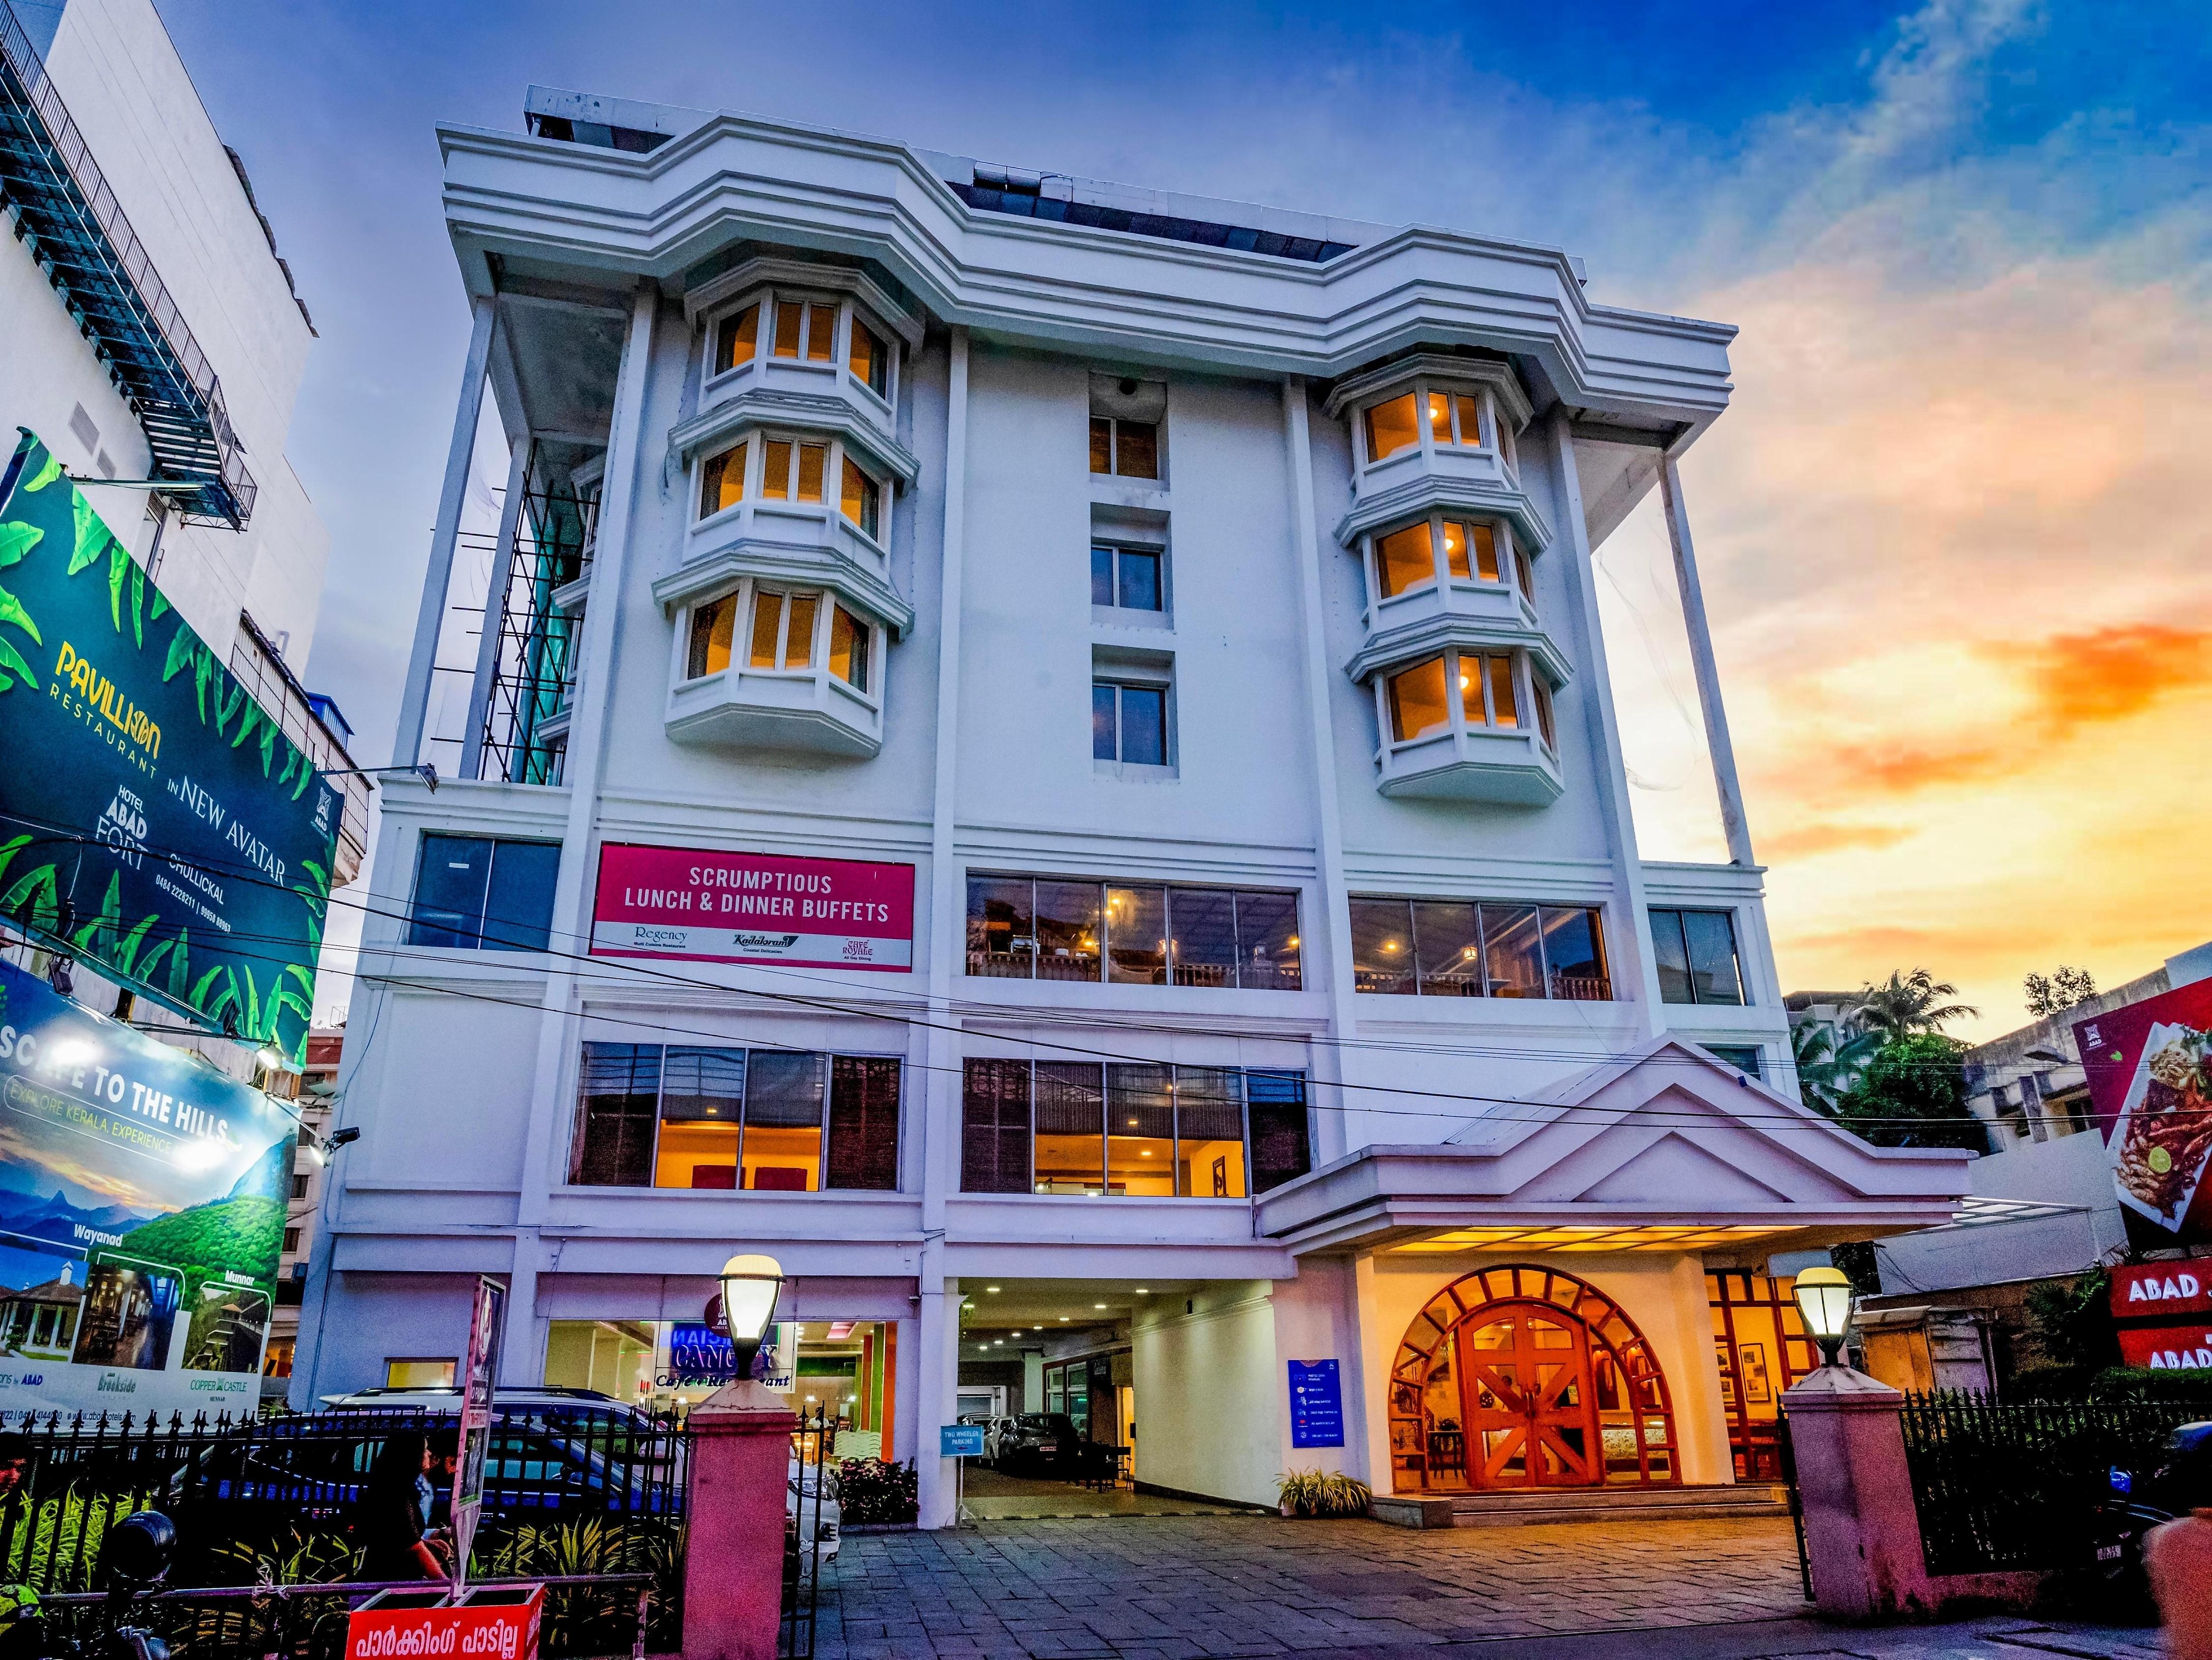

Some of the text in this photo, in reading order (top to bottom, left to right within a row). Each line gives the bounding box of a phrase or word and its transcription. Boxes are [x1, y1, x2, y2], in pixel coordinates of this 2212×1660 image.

[50, 683, 156, 778] RESTAURANT
[118, 785, 144, 814] HOTEL
[106, 796, 147, 840] ABAD
[167, 775, 285, 887] IN NEW AVATAR
[96, 815, 148, 870] FORT
[156, 874, 171, 892] 0484
[171, 885, 195, 908] 2228211
[689, 867, 832, 894] SCRUMPTIOUS
[625, 887, 889, 922] LUNCH & DINNER BUFFETS
[635, 927, 688, 944] Regency
[732, 934, 790, 947] Kadaloram
[842, 947, 873, 956] ROYALE
[0, 1025, 228, 1143] SCAE TO THE HILLS
[10, 1083, 64, 1116] EXPLORE
[112, 1122, 172, 1155] EXPERIENCE
[74, 1224, 123, 1247] Wayanad
[225, 1270, 255, 1287] Munnar
[2129, 1274, 2199, 1302] ABAD
[673, 1345, 778, 1368] CANY
[2150, 1348, 2212, 1369] ABAD
[21, 1374, 43, 1386] ABAD
[190, 1379, 247, 1392] COPPER CASTLE
[463, 1619, 519, 1660] പാടില്ല
